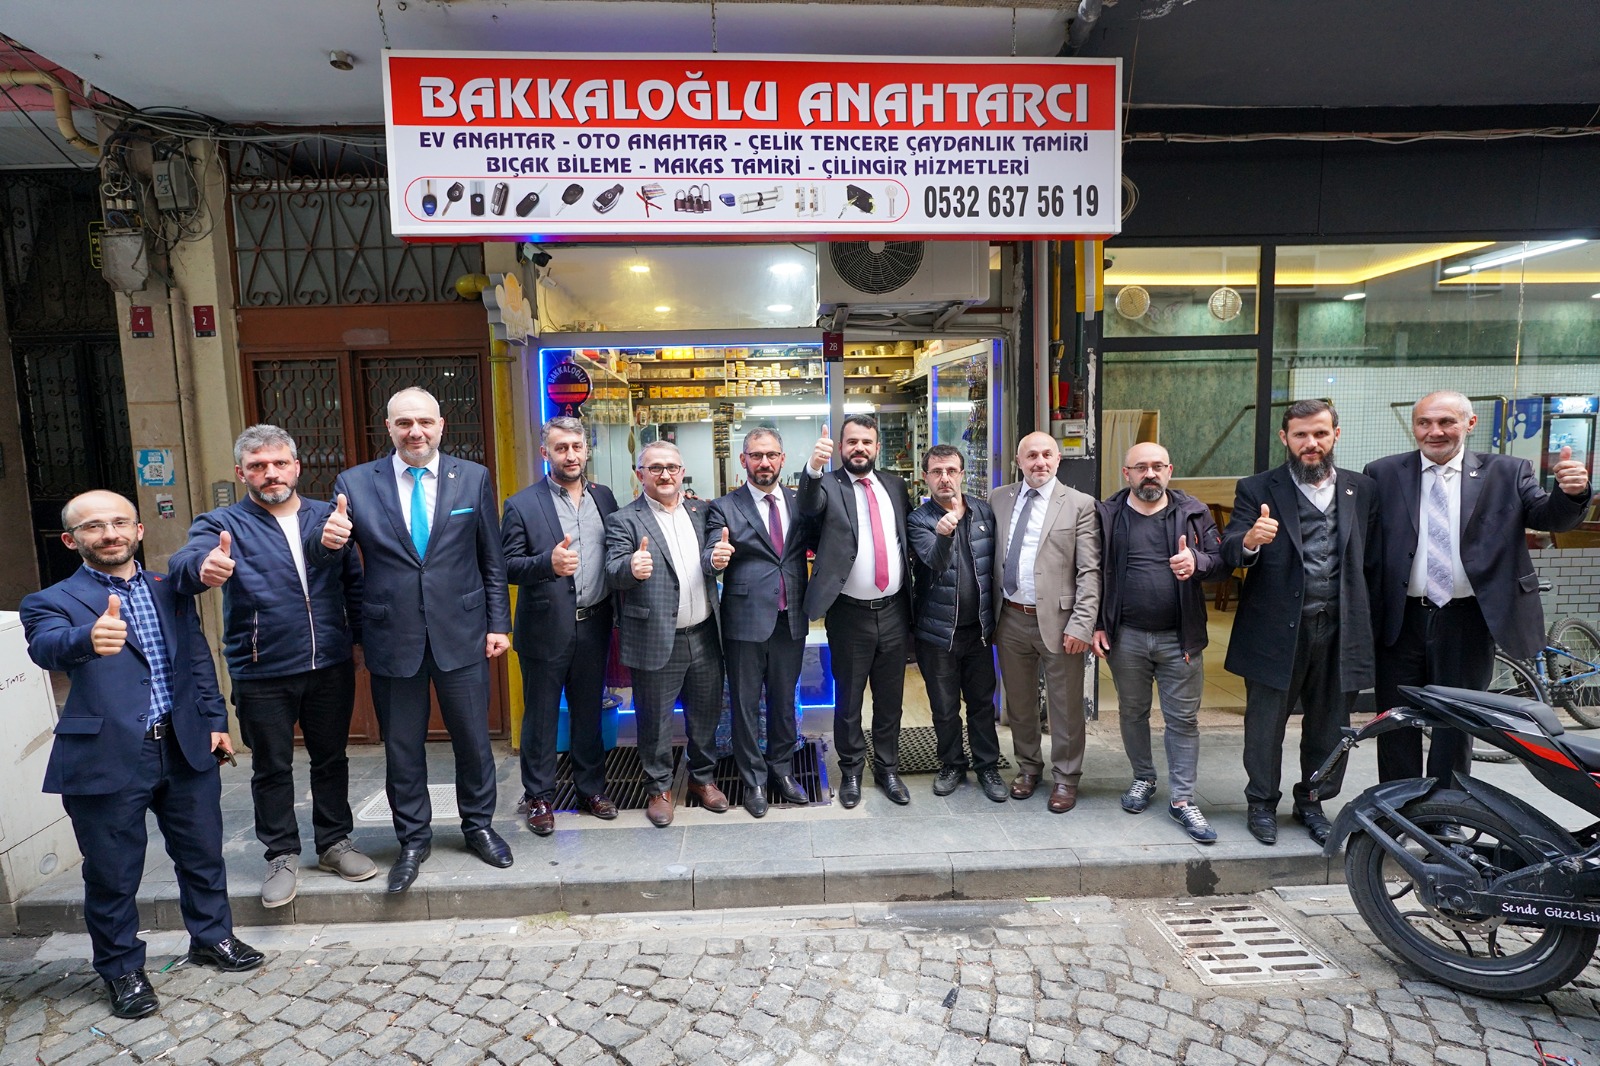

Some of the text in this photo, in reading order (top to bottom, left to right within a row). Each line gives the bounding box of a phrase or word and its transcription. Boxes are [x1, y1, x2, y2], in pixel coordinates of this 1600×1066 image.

[419, 71, 1089, 127] BAKKALOĞLU ANAHTARCI
[419, 131, 446, 148] EV
[452, 132, 556, 151] ANAHTAR
[577, 133, 621, 149] OTO
[627, 133, 728, 152] ANAHTAR
[748, 131, 804, 155] ÇELİK
[810, 134, 899, 152] TENCERE
[906, 135, 1016, 156] ÇAYDANLIK
[1022, 132, 1089, 153] TAMİRİ
[486, 156, 550, 177] BIÇAK
[557, 154, 632, 173] BİLEME
[654, 157, 725, 175] MAKAS
[730, 155, 801, 176] TAMİRİ
[822, 156, 908, 178] ÇİLİNGİR
[914, 155, 1030, 176] HİZMETLERİ
[924, 185, 1099, 218] 0532 637 56 19
[547, 365, 587, 384] BAKKALOĞLU
[1502, 902, 1539, 916] Sende
